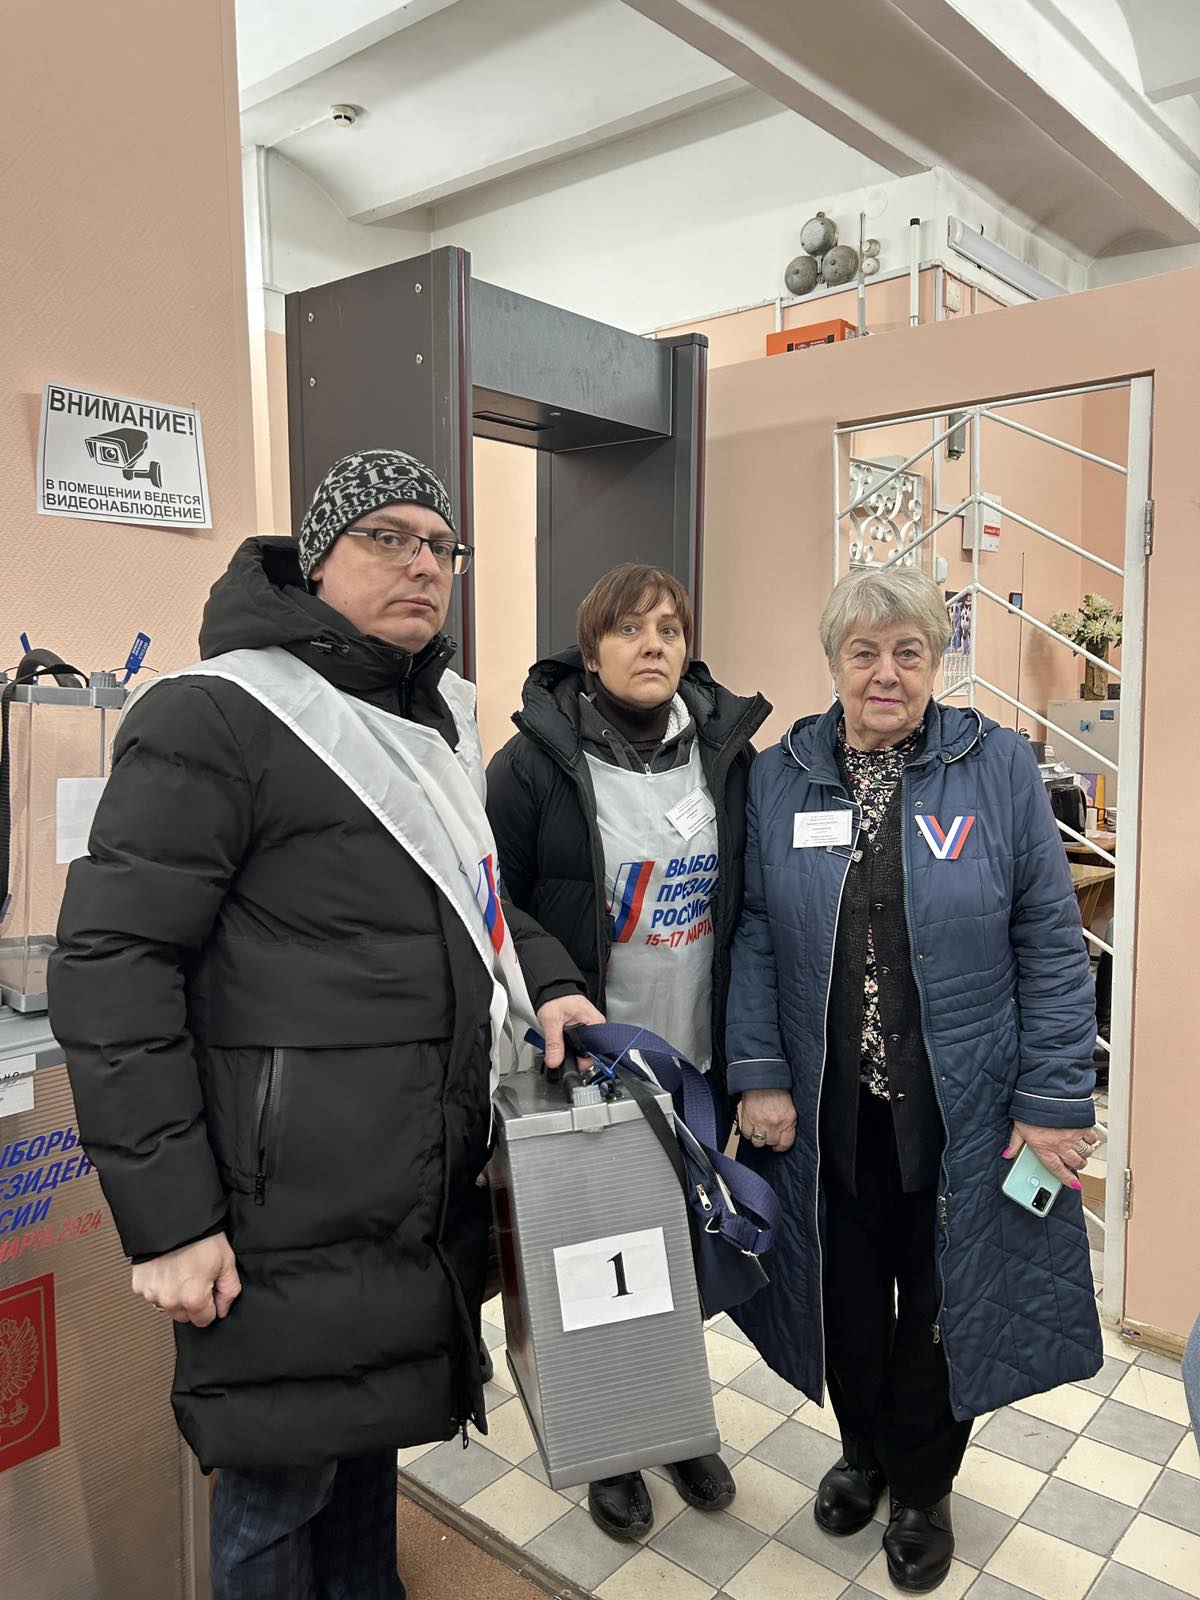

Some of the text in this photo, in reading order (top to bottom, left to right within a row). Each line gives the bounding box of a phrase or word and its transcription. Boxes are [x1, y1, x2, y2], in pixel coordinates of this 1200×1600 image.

[49, 388, 194, 436] ВНИМАНИЕ!
[46, 479, 201, 505] В ПОМЕЩЕНИИ ВЕДЕТСЯ
[46, 493, 202, 519] ВИДЕОНАБЛЮДЕНИЕ
[665, 853, 719, 878] ВЫБО
[645, 917, 713, 949] 15-17 МАРТА
[0, 1127, 80, 1170] БОРЫ
[0, 1196, 53, 1235] СИИ
[607, 1251, 633, 1298] 1
